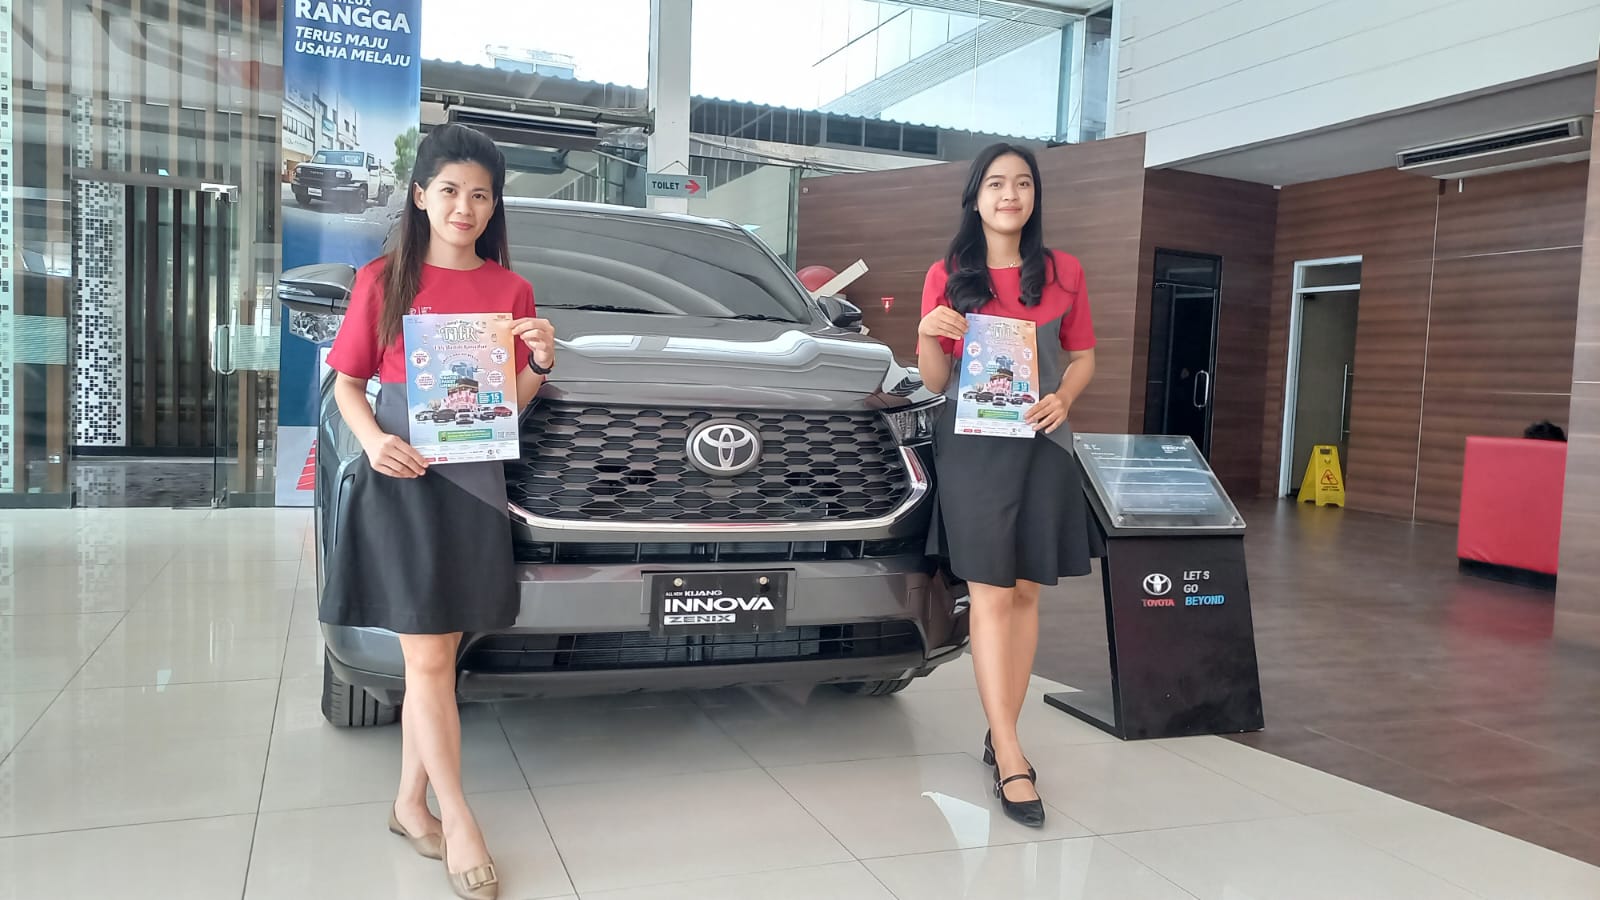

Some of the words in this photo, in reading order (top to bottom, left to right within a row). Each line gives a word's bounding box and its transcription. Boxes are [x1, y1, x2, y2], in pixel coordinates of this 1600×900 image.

[295, 0, 411, 34] RANGGA
[295, 26, 342, 44] TERUS
[345, 33, 389, 50] MAJU
[295, 41, 348, 60] USAHA
[350, 48, 411, 67] MELAJU
[652, 181, 680, 190] TOILET
[684, 589, 723, 597] KIJANG
[1183, 584, 1199, 594] GO
[664, 596, 775, 613] INNOVA
[1142, 599, 1175, 607] TOYOTA
[1185, 594, 1225, 606] BEYOND
[668, 614, 732, 624] ZENIX
